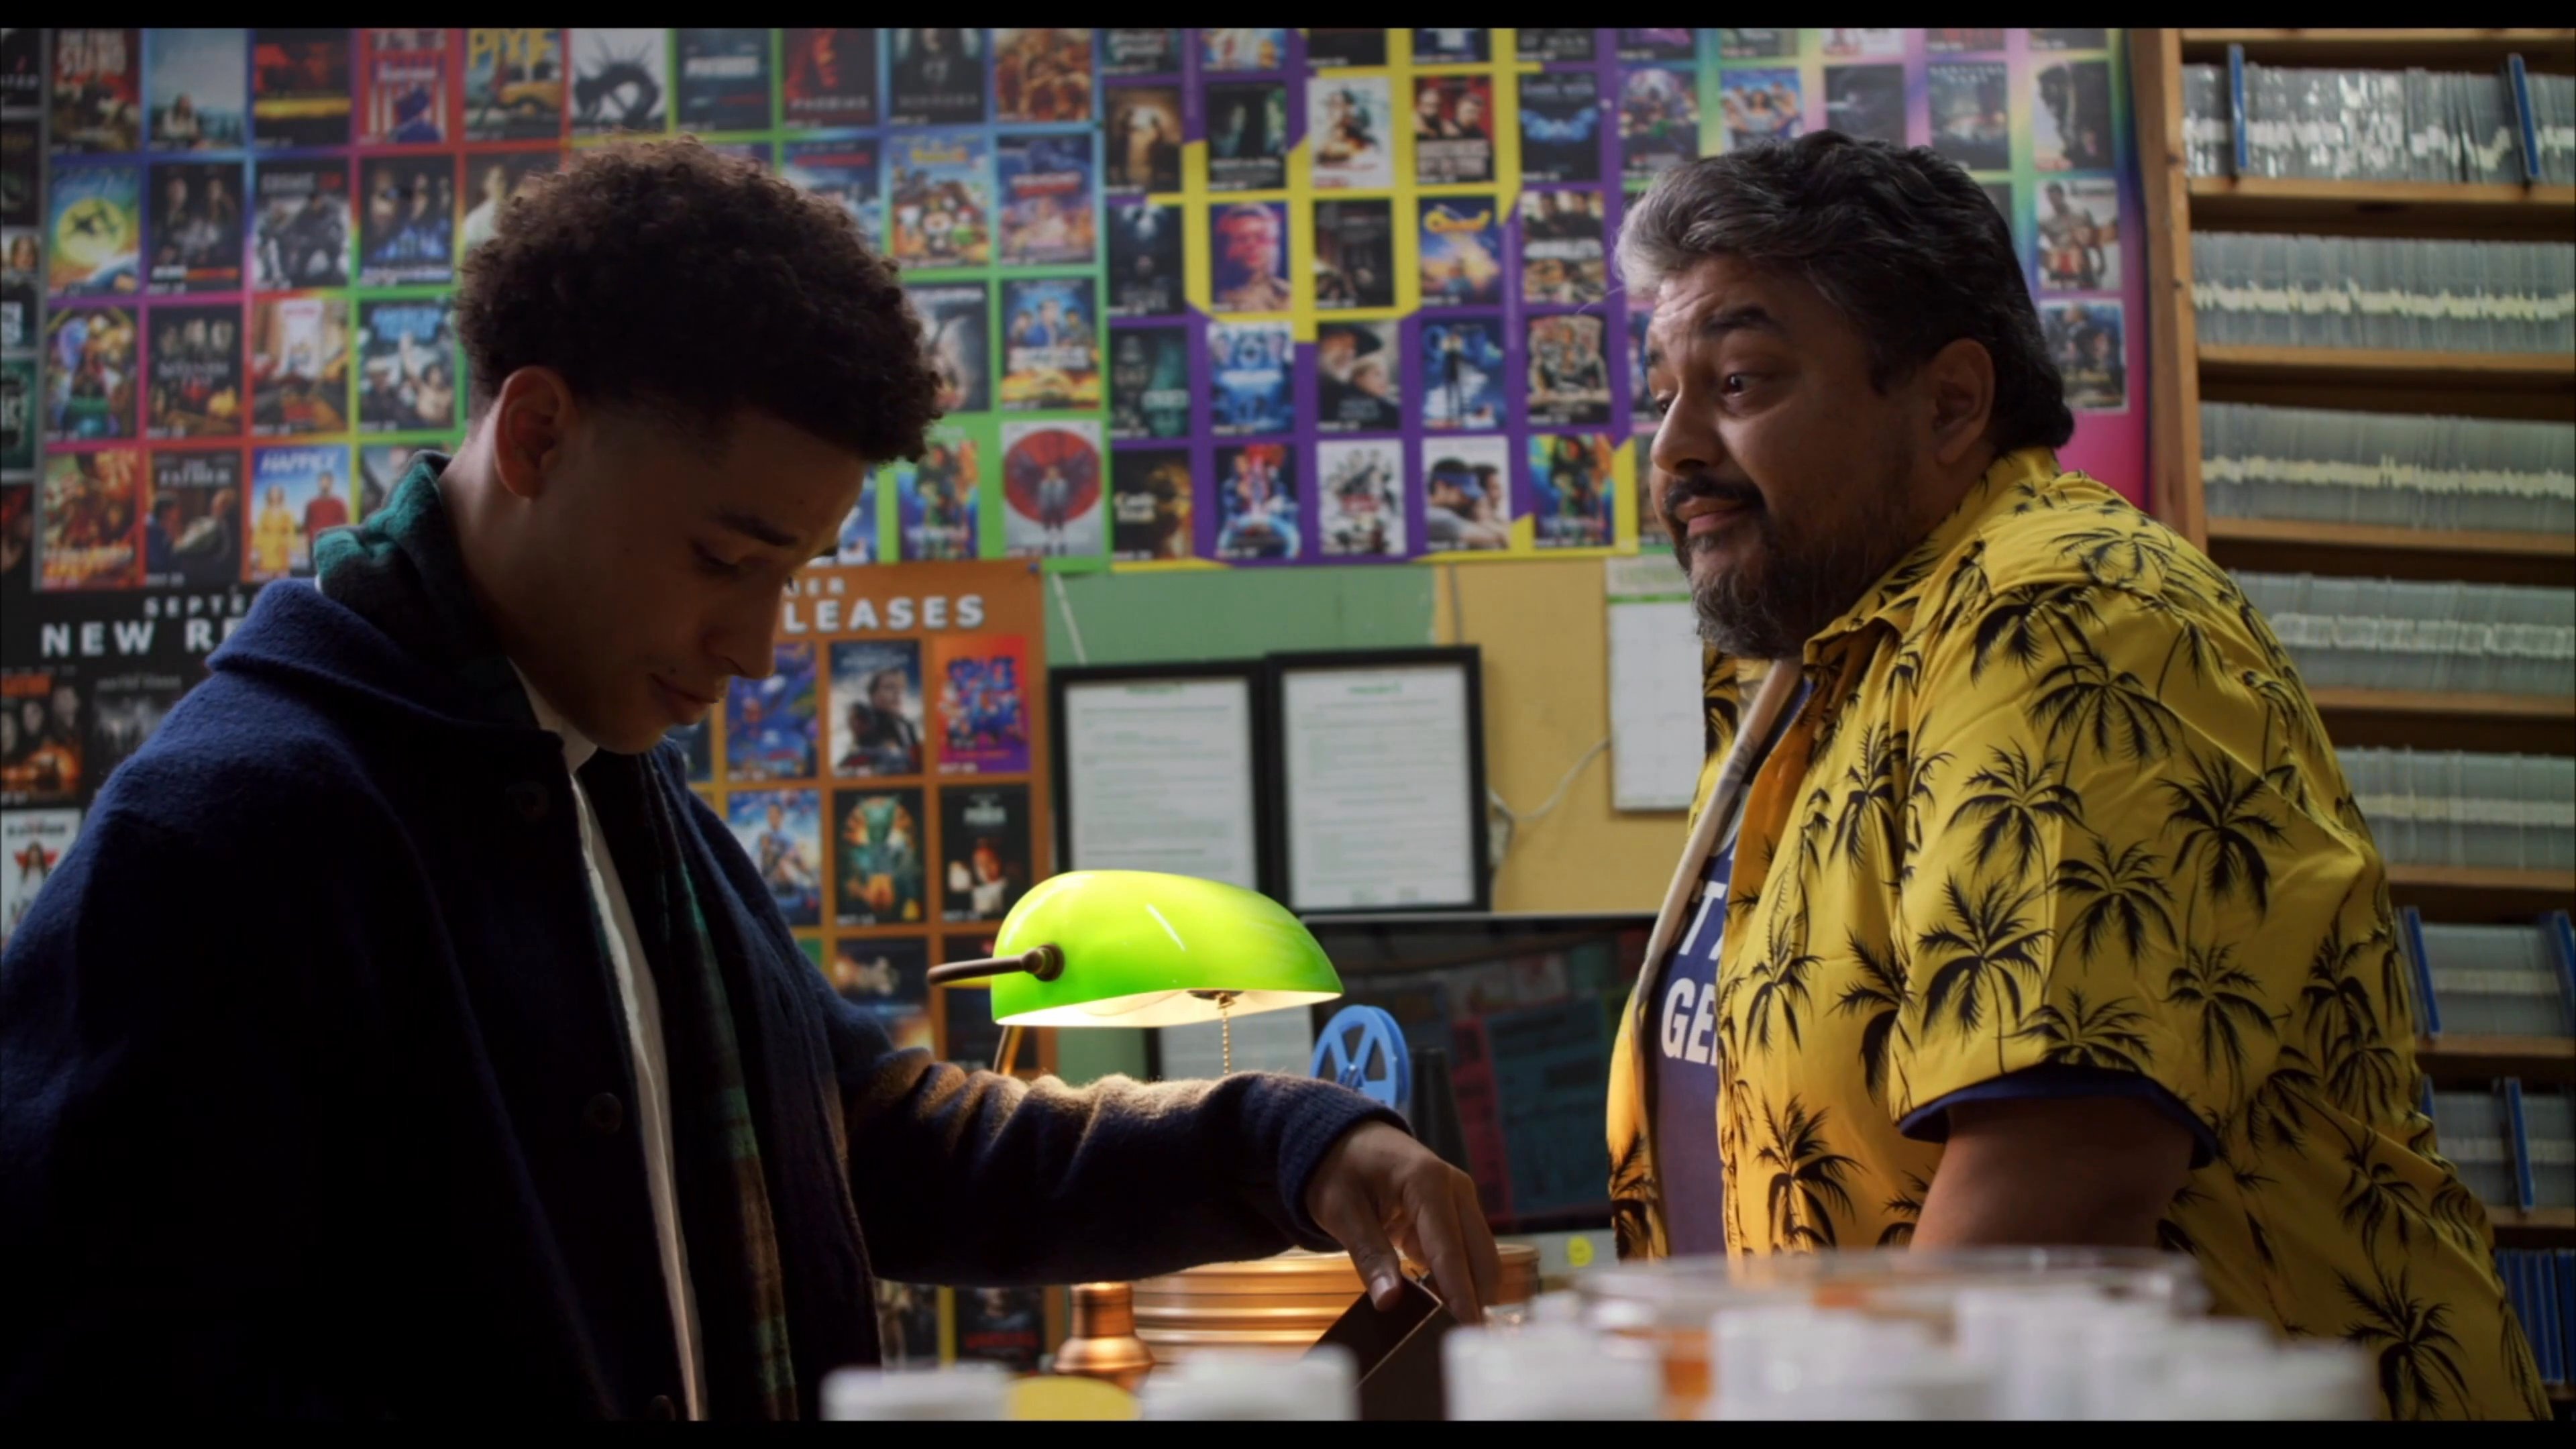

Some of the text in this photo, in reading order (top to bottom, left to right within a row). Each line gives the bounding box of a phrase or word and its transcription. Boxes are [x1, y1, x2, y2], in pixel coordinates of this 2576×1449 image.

[144, 594, 258, 619] SEPTE
[784, 593, 985, 634] LEASES
[41, 621, 156, 657] NEW
[1660, 977, 1718, 1067] GE
